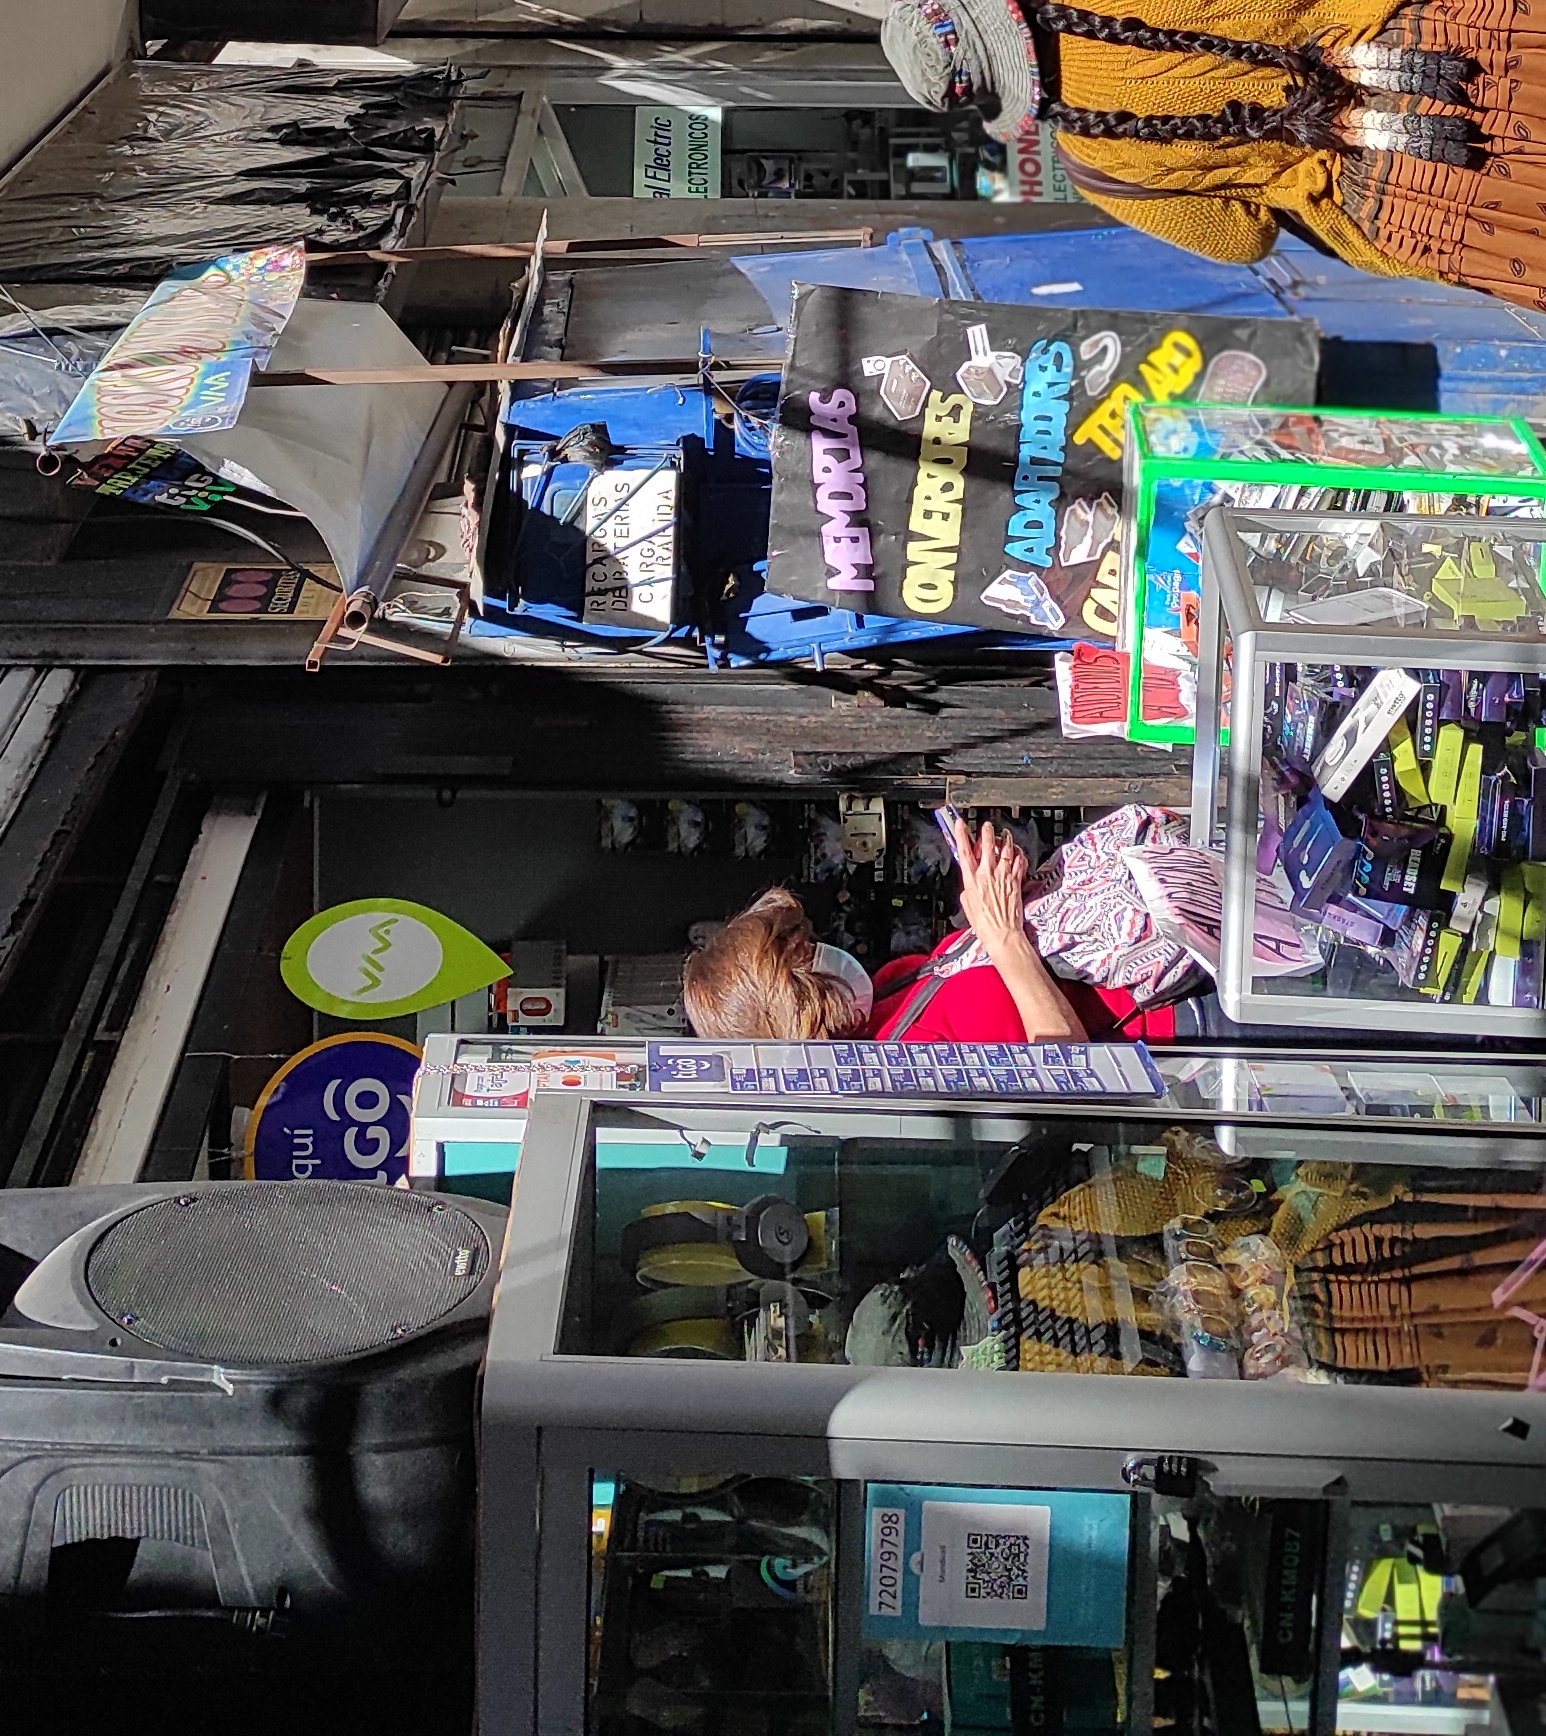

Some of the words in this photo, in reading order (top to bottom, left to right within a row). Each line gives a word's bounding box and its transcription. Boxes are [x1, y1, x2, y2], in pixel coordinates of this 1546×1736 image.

[643, 116, 672, 183] Electric
[687, 114, 709, 199] ECTRONICOS
[808, 388, 875, 592] MEMORIAS
[901, 388, 974, 615] CONVERSORES
[1003, 336, 1075, 568] ADAPTADORES
[589, 496, 608, 612] RECARGAS
[613, 482, 631, 581] BATERIAS
[638, 533, 656, 604] CARGA
[267, 570, 301, 613] SECURITAS
[611, 586, 629, 612] DE
[283, 1126, 322, 1180] quí
[877, 1512, 900, 1613] 72079798
[1277, 1526, 1303, 1644] CN-KM087
